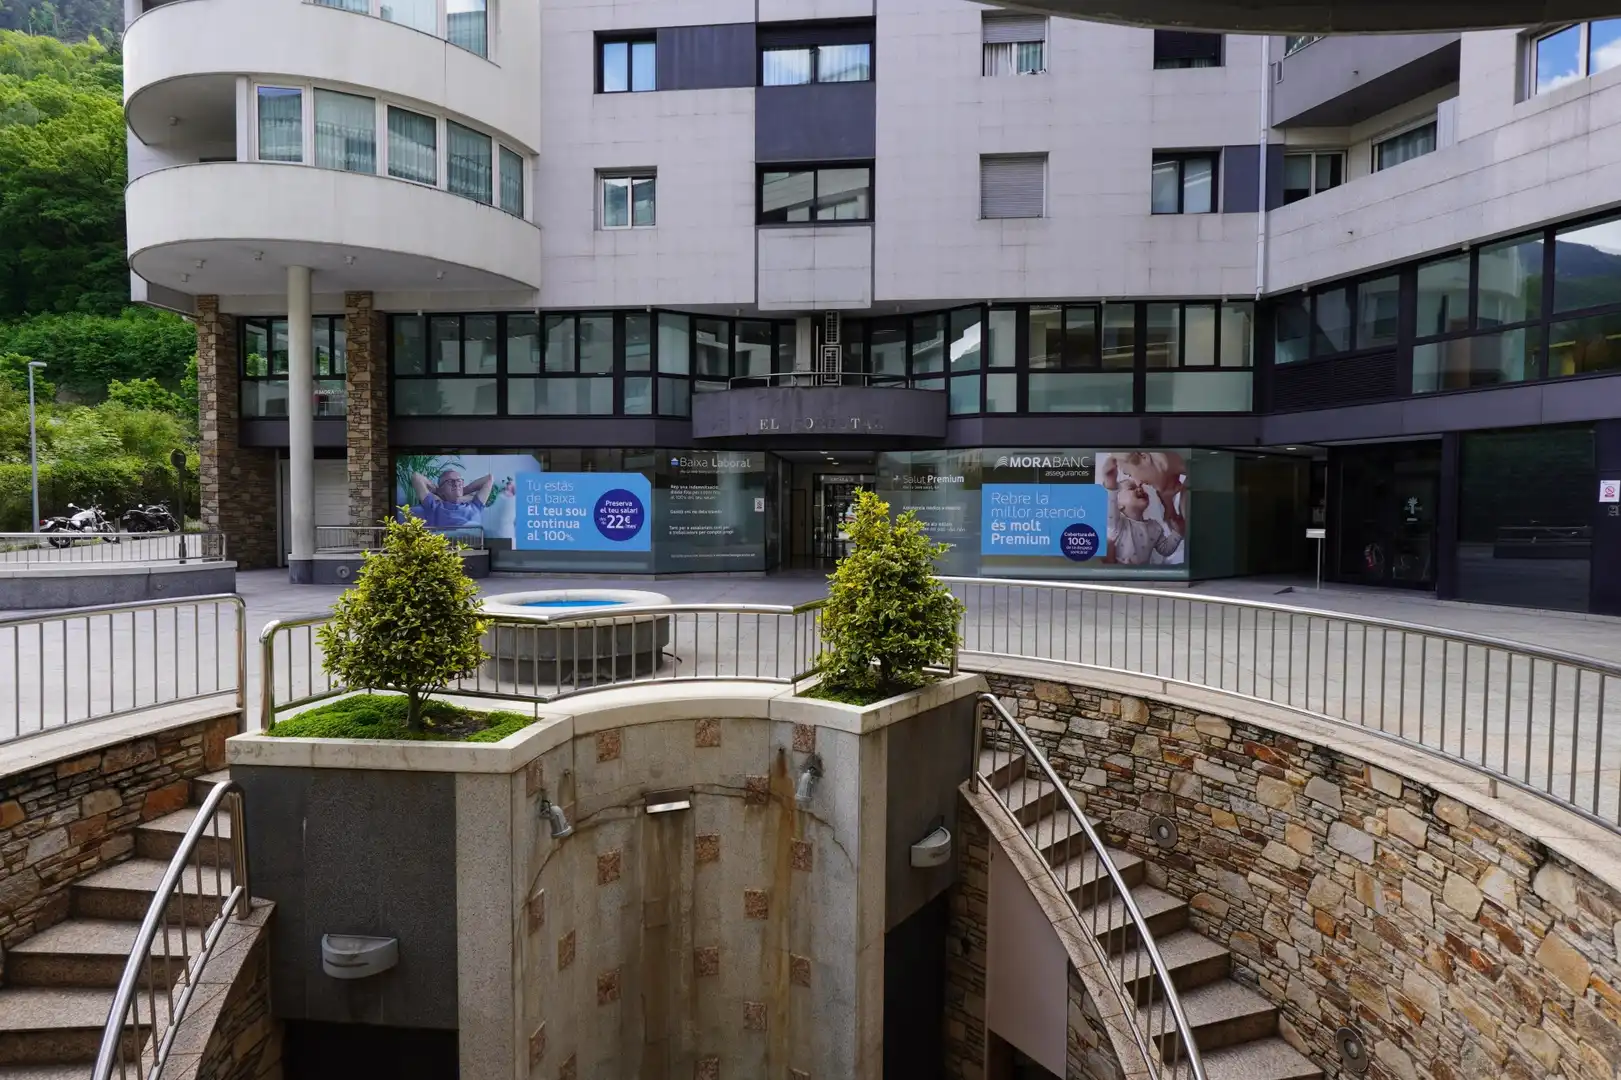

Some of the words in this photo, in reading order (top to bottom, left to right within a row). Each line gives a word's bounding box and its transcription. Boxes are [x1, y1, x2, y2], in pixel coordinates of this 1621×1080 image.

[760, 418, 780, 430] EL
[680, 457, 708, 468] Baixa
[711, 458, 751, 468] Laboral
[1009, 456, 1090, 468] MORABANC
[903, 475, 926, 484] Salut
[927, 474, 965, 483] Premium
[1045, 470, 1090, 478] assegurances
[527, 480, 541, 491] Tu
[526, 493, 541, 504] de
[992, 492, 1031, 504] Rebre
[1036, 491, 1049, 504] la
[527, 505, 539, 516] El
[543, 506, 563, 516] teu
[565, 508, 587, 516] sou
[991, 506, 1032, 518] millor
[1035, 506, 1086, 519] atenció
[527, 518, 580, 529] continua
[991, 519, 1006, 531] és
[1010, 520, 1042, 531] molt
[527, 531, 538, 541] al
[991, 533, 1050, 545] Premium
[1068, 537, 1091, 545] 100%
